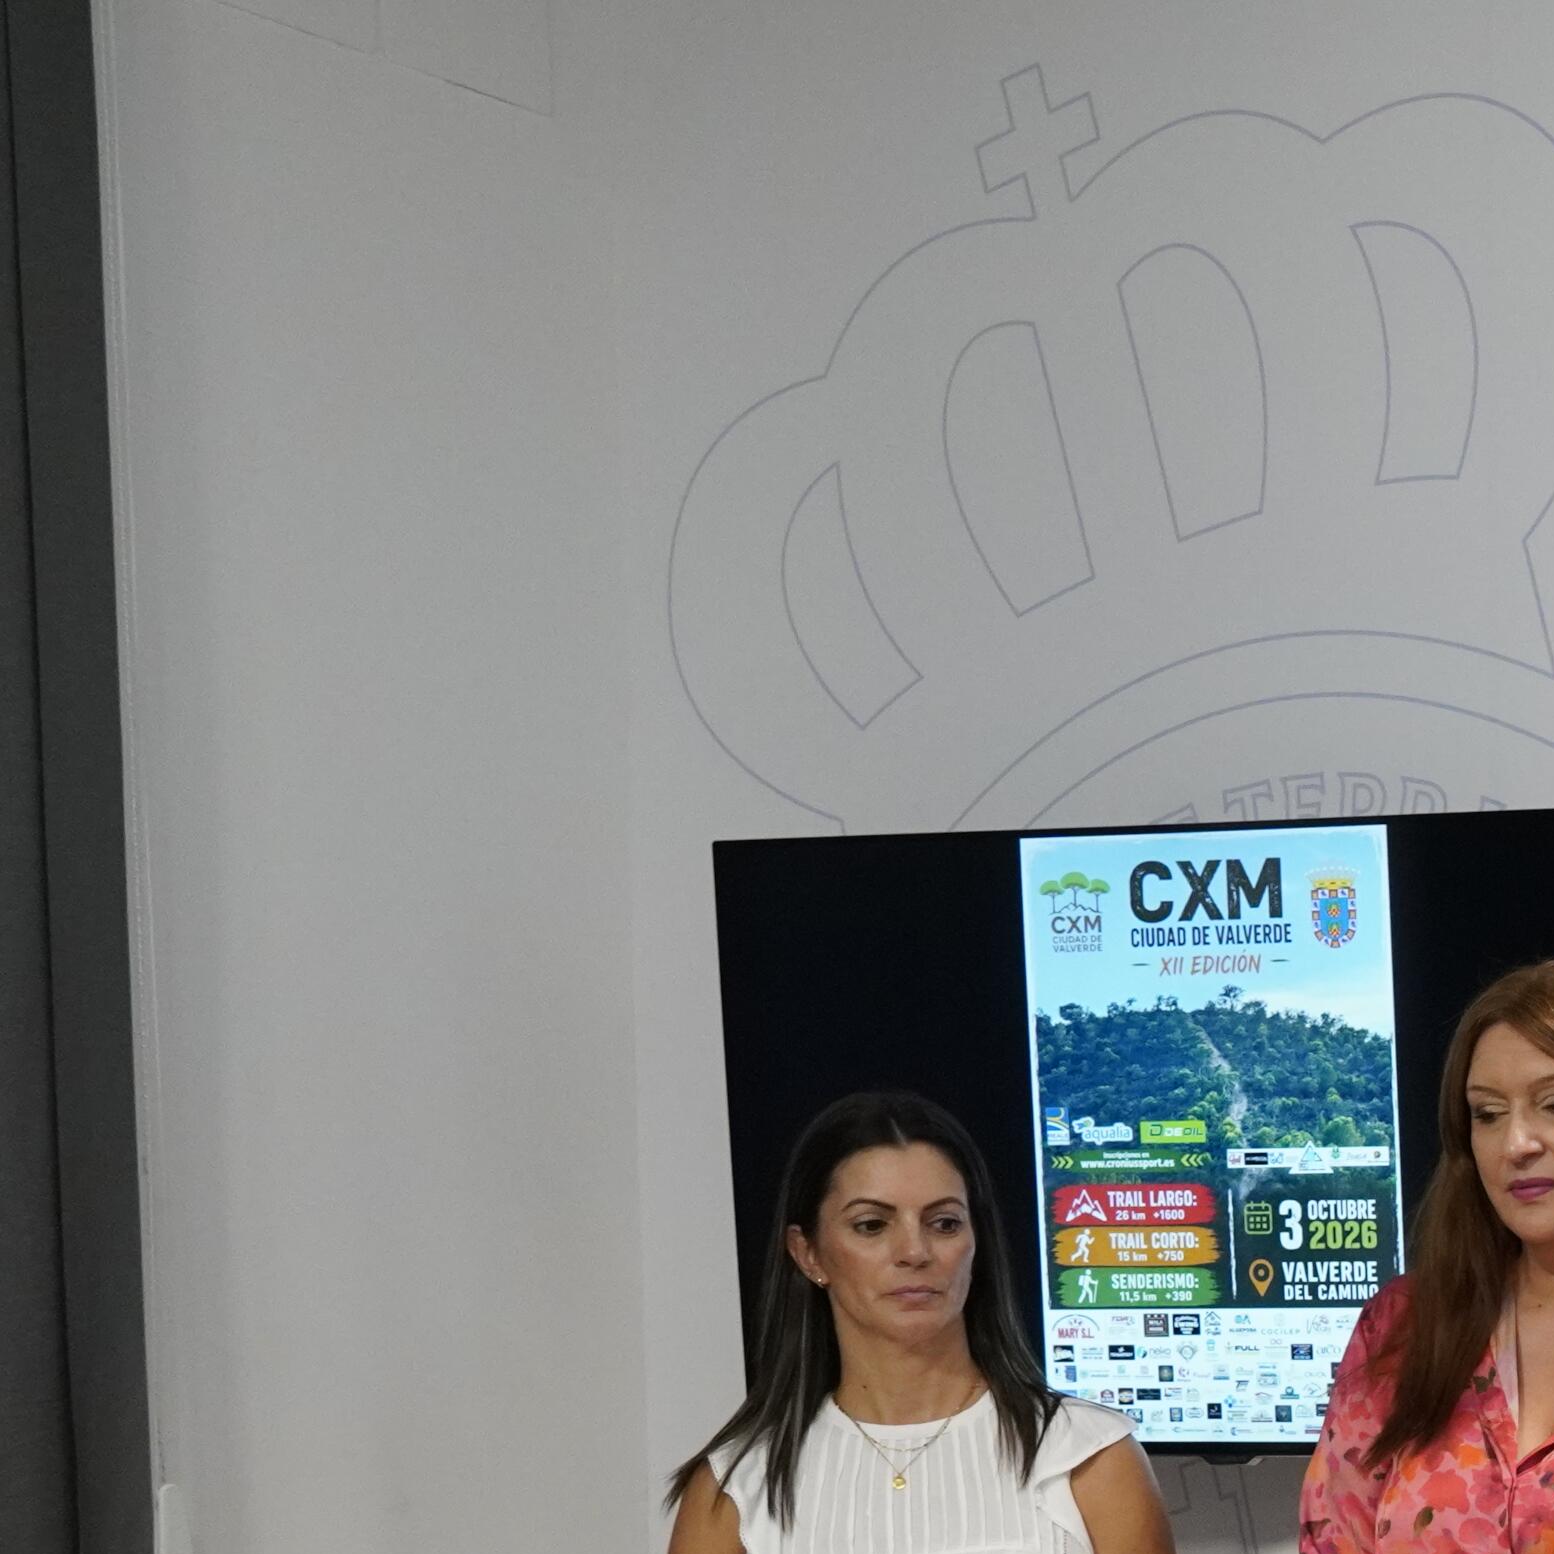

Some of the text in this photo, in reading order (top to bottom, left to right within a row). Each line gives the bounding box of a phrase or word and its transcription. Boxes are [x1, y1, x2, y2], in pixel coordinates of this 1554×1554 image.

[1129, 857, 1284, 923] CXM
[1051, 915, 1102, 934] CXM
[1052, 934, 1103, 944] CIUDAD DE
[1131, 924, 1292, 947] CIUDAD DE VALVERDE
[1052, 944, 1104, 953] VALVERDE
[1159, 949, 1261, 976] XII EDICIÓN
[1084, 1125, 1130, 1142] aqualia
[1107, 1190, 1197, 1207] TRAIL LARGO:
[1115, 1209, 1185, 1220] 26 km +1600
[1279, 1199, 1377, 1250] 3 OCTUBRE
[1109, 1232, 1199, 1249] TRAIL CORTO:
[1308, 1220, 1378, 1249] 2026
[1117, 1251, 1184, 1261] 15 km +750
[1281, 1261, 1378, 1282] VALVERDE
[1111, 1273, 1199, 1289] SENDERISMO:
[1119, 1291, 1193, 1303] 11,5 km +390
[1283, 1284, 1379, 1300] DEL CAMINO
[1057, 1328, 1079, 1338] MARY
